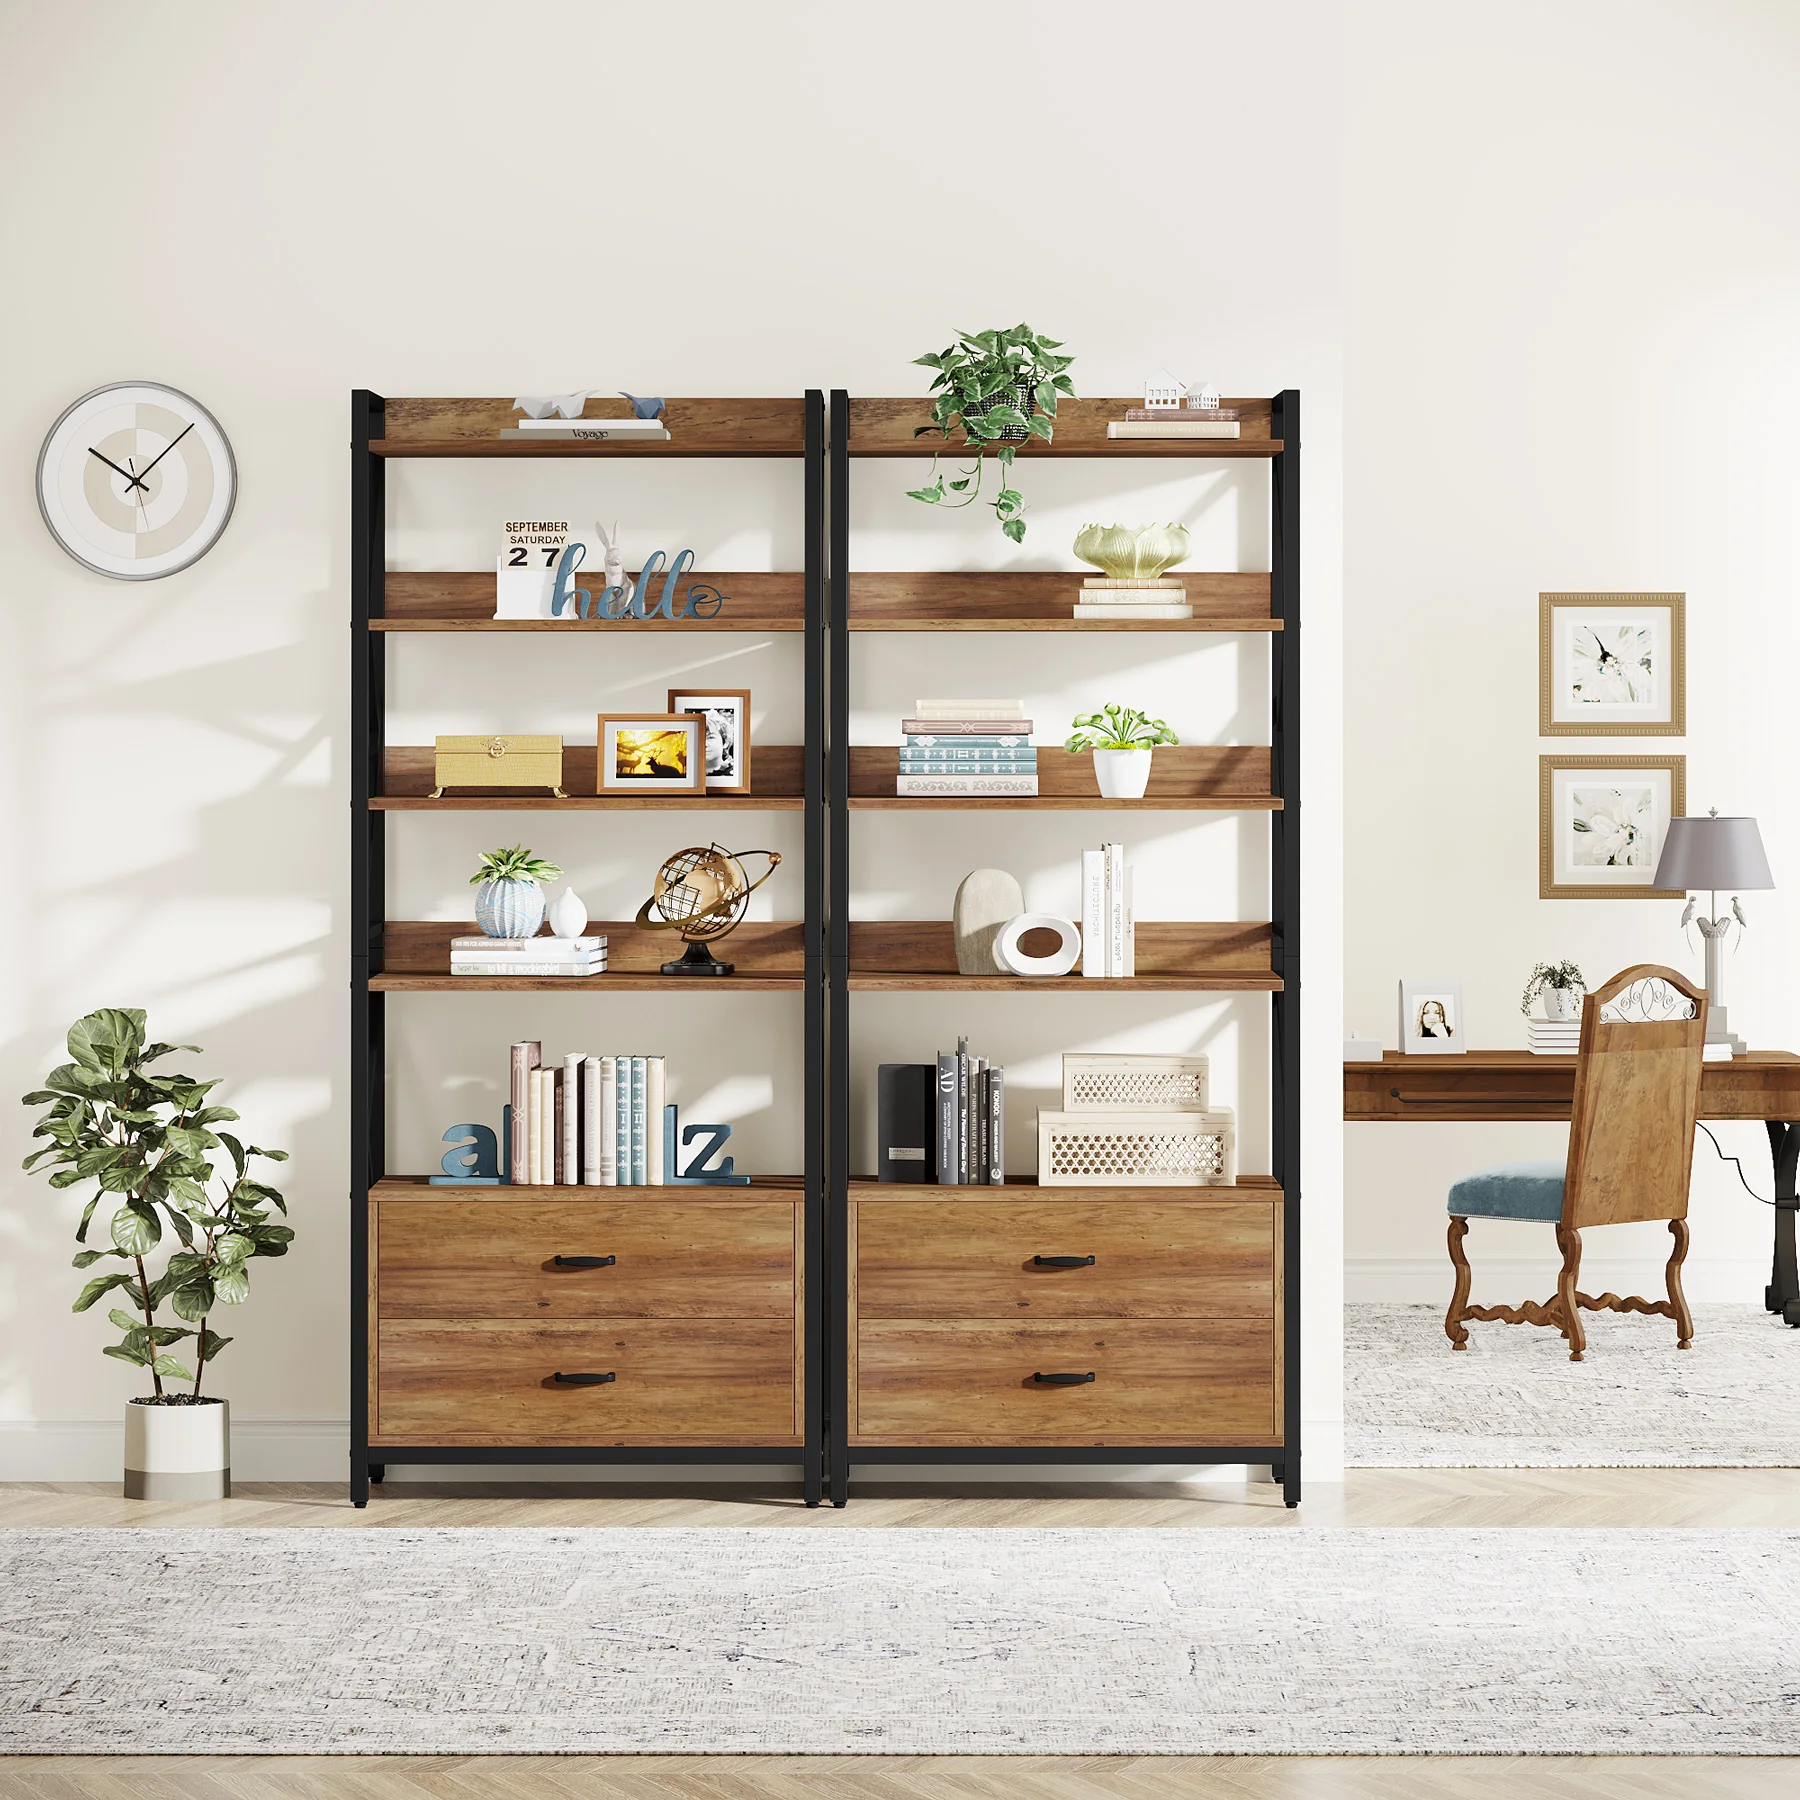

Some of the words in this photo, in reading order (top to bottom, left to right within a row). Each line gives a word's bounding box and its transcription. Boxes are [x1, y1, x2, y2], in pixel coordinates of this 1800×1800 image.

[505, 521, 568, 532] SEPTEMBER
[510, 535, 566, 544] SATURDAY
[551, 543, 731, 620] hello
[487, 964, 495, 973] to
[496, 963, 506, 973] kill
[514, 963, 559, 976] mockingbird
[941, 1067, 954, 1093] AD
[442, 1124, 498, 1177] a
[683, 1124, 734, 1177] z
